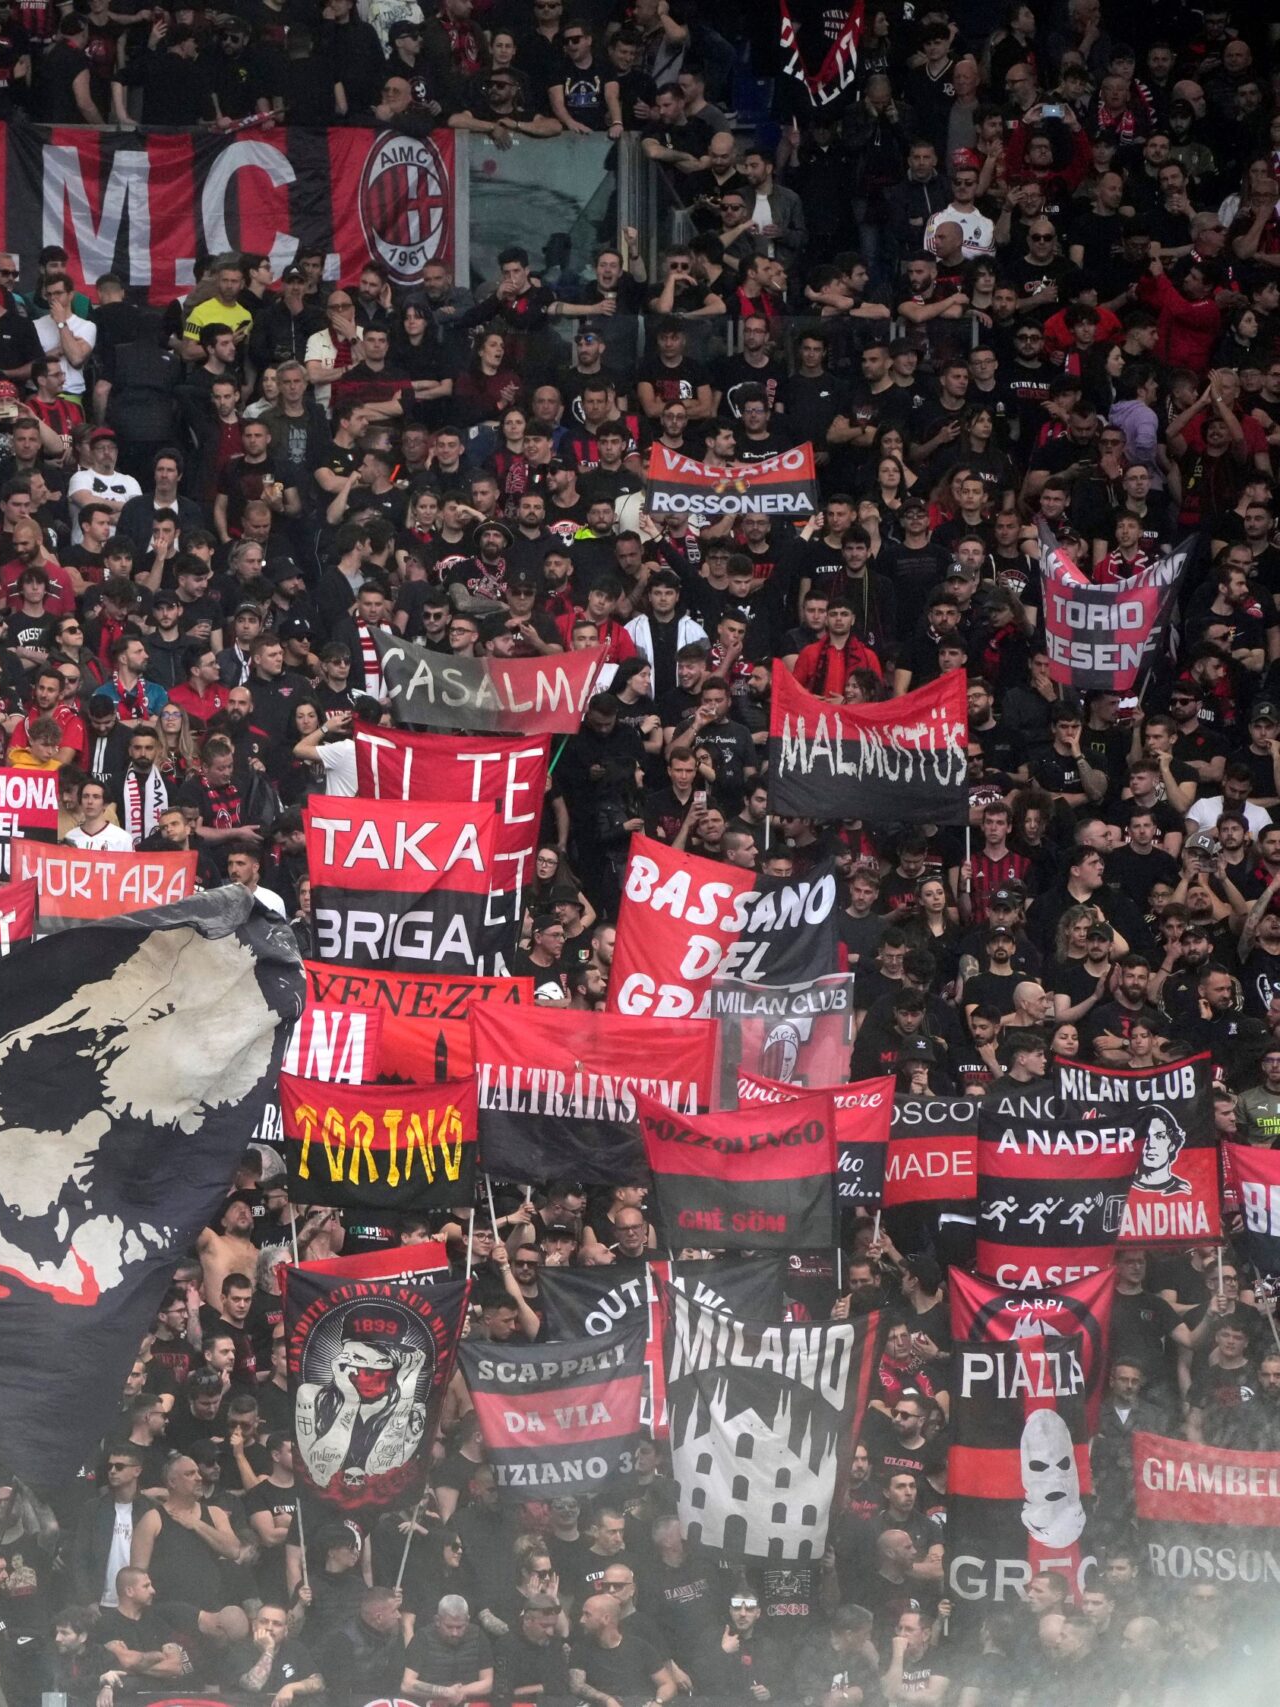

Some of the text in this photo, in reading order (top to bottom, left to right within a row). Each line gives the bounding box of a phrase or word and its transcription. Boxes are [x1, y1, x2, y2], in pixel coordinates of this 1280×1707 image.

[652, 491, 815, 514] ROSSONERA
[778, 707, 967, 786] MALMUSTÜS
[311, 817, 485, 873] TAKA
[22, 853, 186, 905] MORTARA
[625, 854, 837, 933] BASSANO
[680, 934, 771, 981] DEL
[310, 970, 521, 1021] VENEZIA
[716, 988, 848, 1015] MILAN CLUB
[1060, 1066, 1196, 1102] MILAN CLUB
[294, 1103, 463, 1188] TORINO
[996, 1127, 1136, 1156] A NADER
[732, 1209, 787, 1233] SÖM
[330, 1282, 391, 1304] CURVA
[397, 1284, 434, 1315] SUD
[1005, 1297, 1064, 1313] CARPI
[353, 1317, 399, 1335] 1899
[478, 1344, 627, 1383] SCAPPATI
[669, 1294, 855, 1412] MILANO
[961, 1350, 1087, 1399] PIAZZA
[504, 1410, 545, 1434] DA
[553, 1401, 613, 1429] VIA
